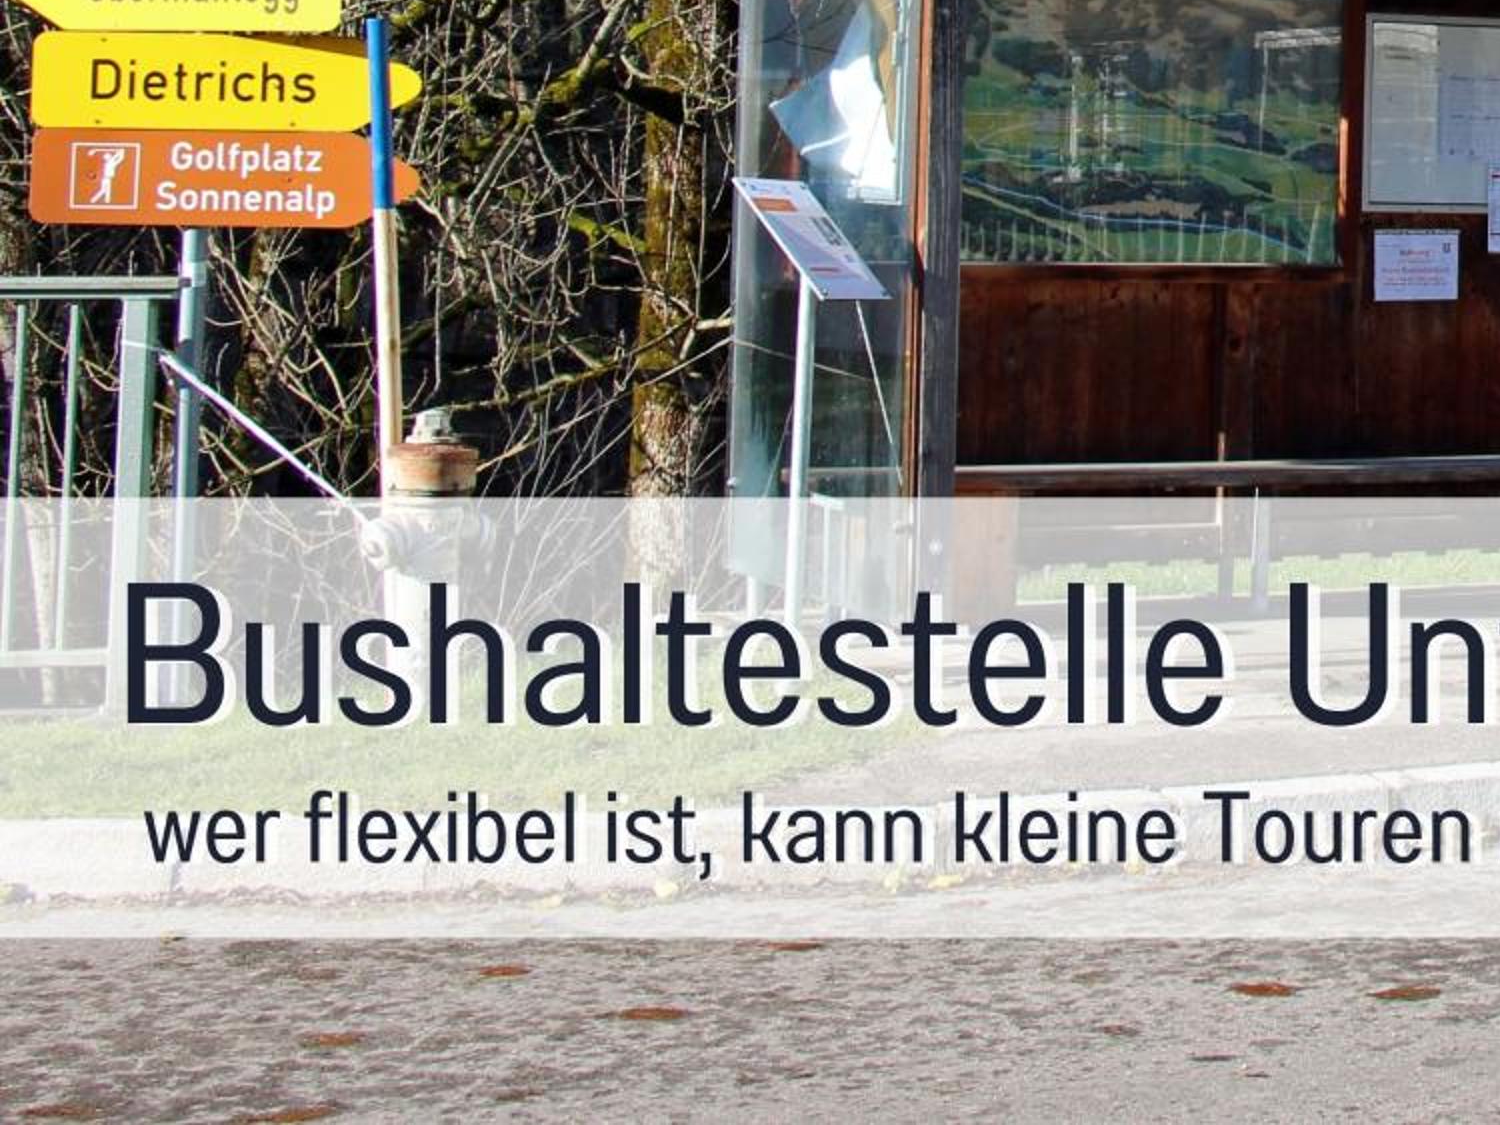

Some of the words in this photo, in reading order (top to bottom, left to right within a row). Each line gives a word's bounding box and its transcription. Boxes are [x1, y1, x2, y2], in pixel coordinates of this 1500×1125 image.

[90, 58, 317, 102] Dietrichs
[170, 141, 324, 185] Golfplatz
[155, 181, 337, 225] Sonnenalp
